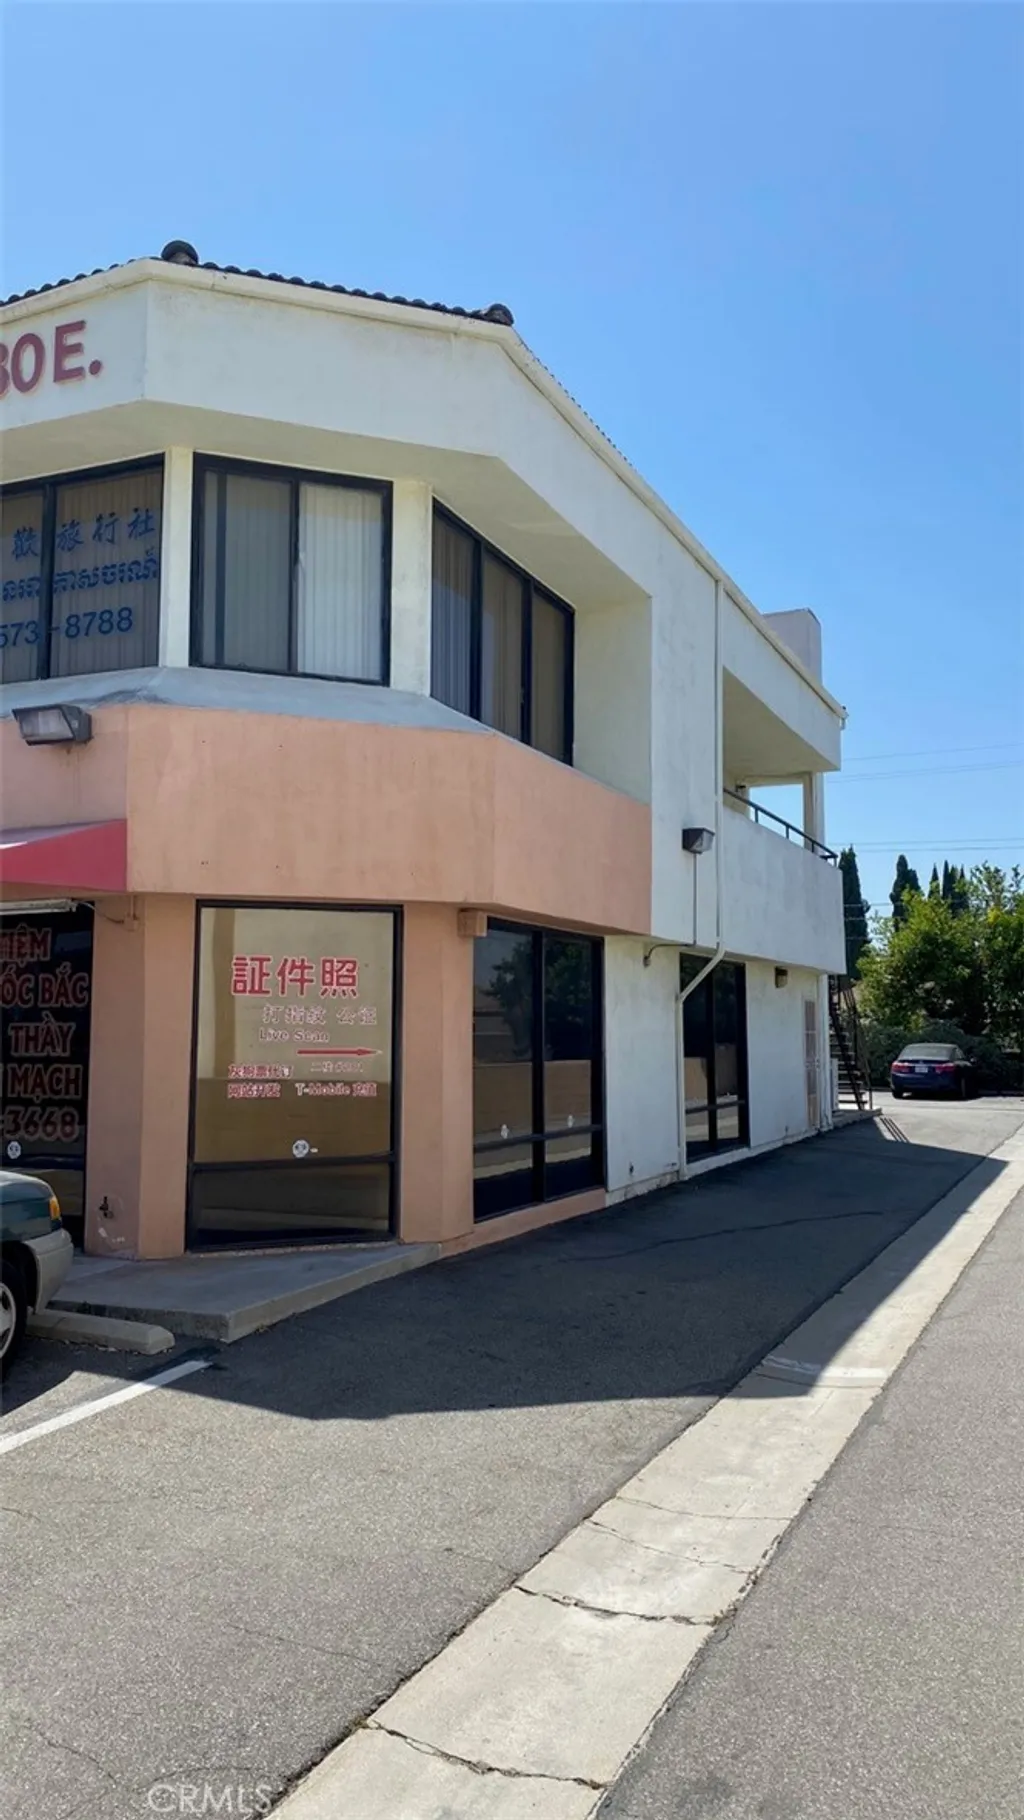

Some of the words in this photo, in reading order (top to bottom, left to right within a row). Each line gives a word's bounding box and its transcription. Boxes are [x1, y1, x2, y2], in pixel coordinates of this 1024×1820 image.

[53, 320, 103, 383] E.
[232, 954, 359, 998] 証件照
[259, 1027, 289, 1042] Live
[293, 1028, 330, 1042] Scan
